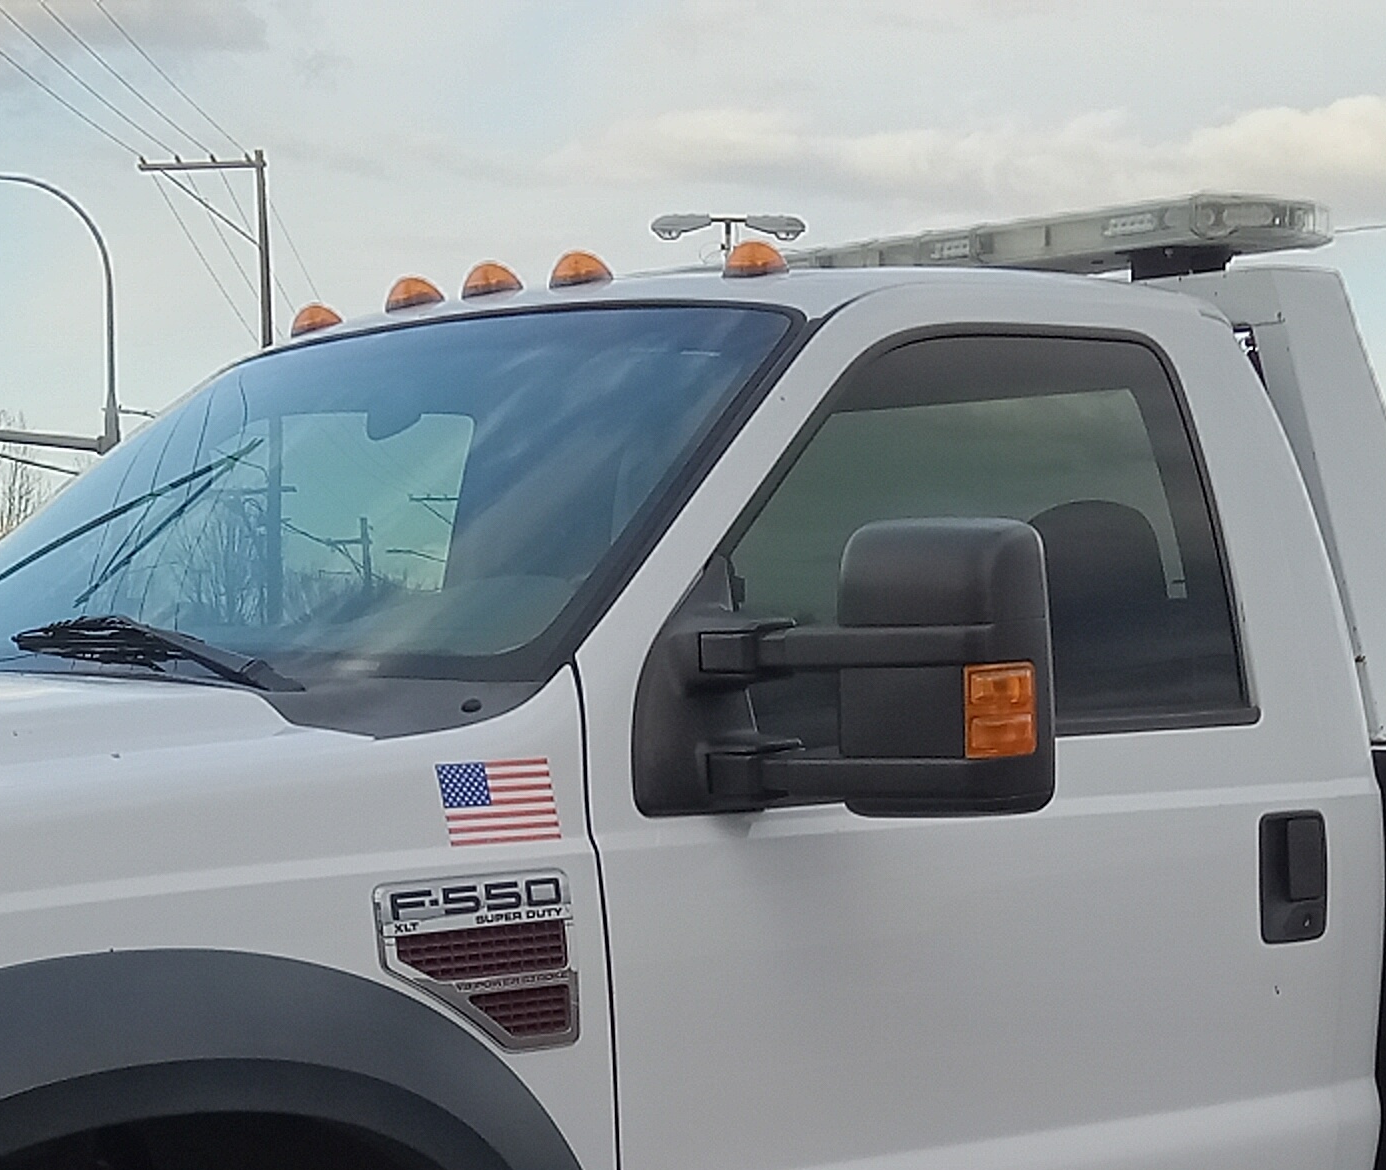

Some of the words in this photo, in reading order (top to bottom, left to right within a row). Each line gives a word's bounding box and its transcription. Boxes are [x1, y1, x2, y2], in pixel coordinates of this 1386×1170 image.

[390, 877, 562, 921] F-550
[394, 922, 419, 934] XLT
[476, 911, 522, 925] SUPER
[526, 907, 562, 920] DUTY
